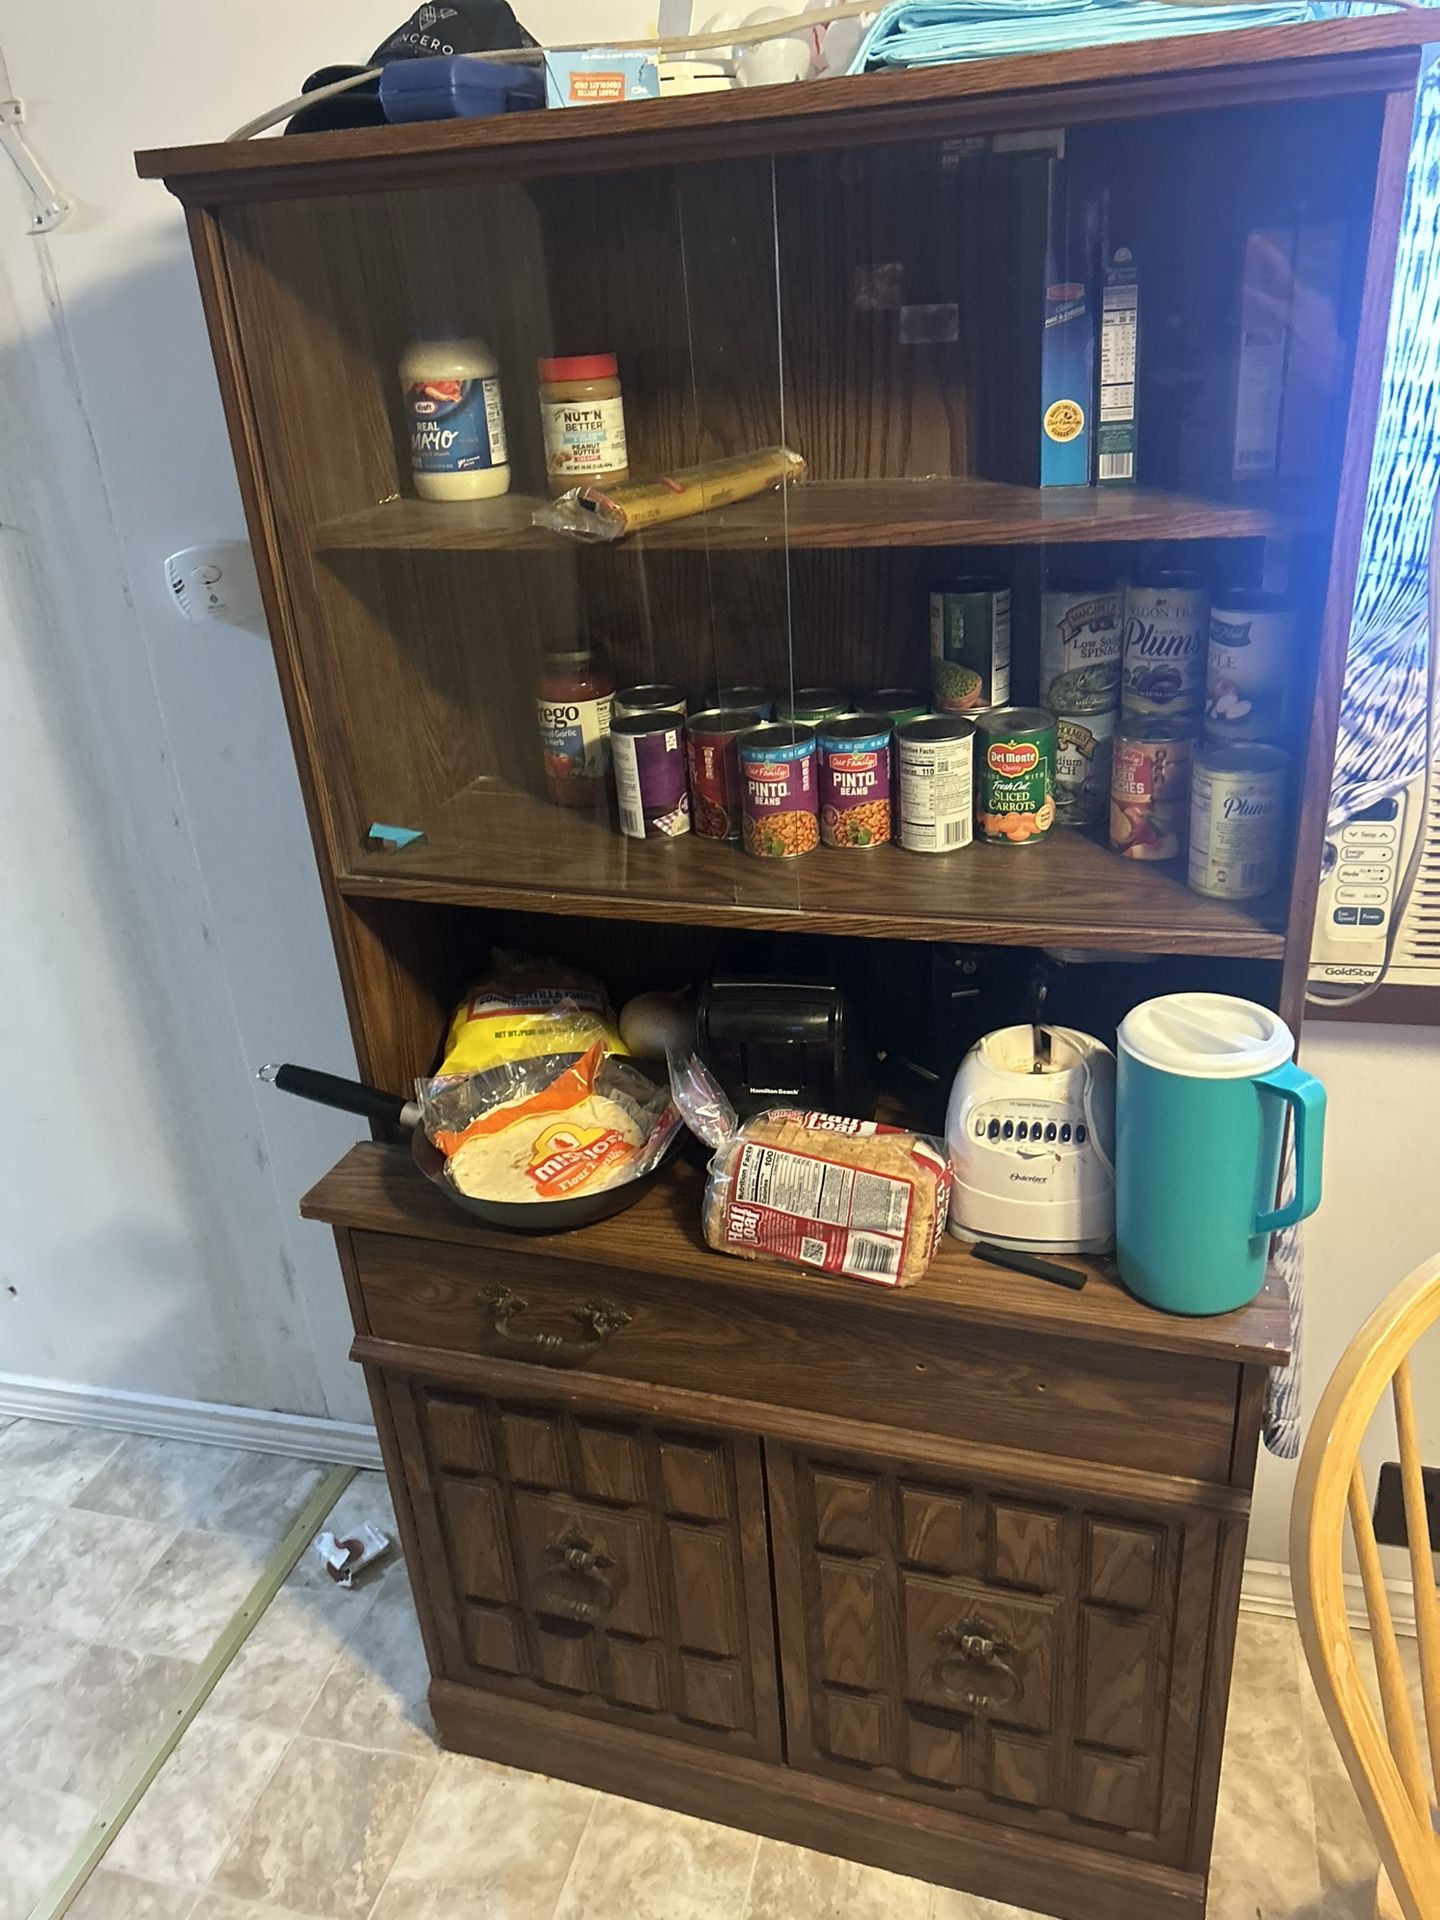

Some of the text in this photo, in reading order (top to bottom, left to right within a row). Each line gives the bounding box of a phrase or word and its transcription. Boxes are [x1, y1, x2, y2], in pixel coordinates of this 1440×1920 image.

[417, 403, 432, 411] Kraft
[564, 410, 602, 422] NUT'N
[416, 421, 440, 431] REAL
[565, 422, 603, 432] BETTER
[411, 430, 459, 450] MAYO
[555, 729, 577, 738] Garlic
[832, 754, 875, 769] Our Family
[991, 751, 1035, 762] Del Monte
[1056, 756, 1082, 766] dium
[759, 765, 787, 779] Family
[833, 772, 875, 787] PINTO
[992, 780, 1032, 791] Fresh Cut
[748, 780, 788, 797] PINTO
[840, 786, 868, 796] BEANS
[755, 797, 780, 806] BEANS
[994, 790, 1030, 802] SLICED
[989, 799, 1036, 811] CARROTS
[1325, 967, 1378, 977] GoldStar
[750, 1087, 777, 1095] Hamilton
[806, 1119, 858, 1135] Loaf
[765, 1150, 774, 1167] 100
[559, 1166, 590, 1192] Flour
[737, 1146, 753, 1200] Nutrition Facts
[728, 1205, 747, 1242] Half
[743, 1209, 761, 1244] Loaf
